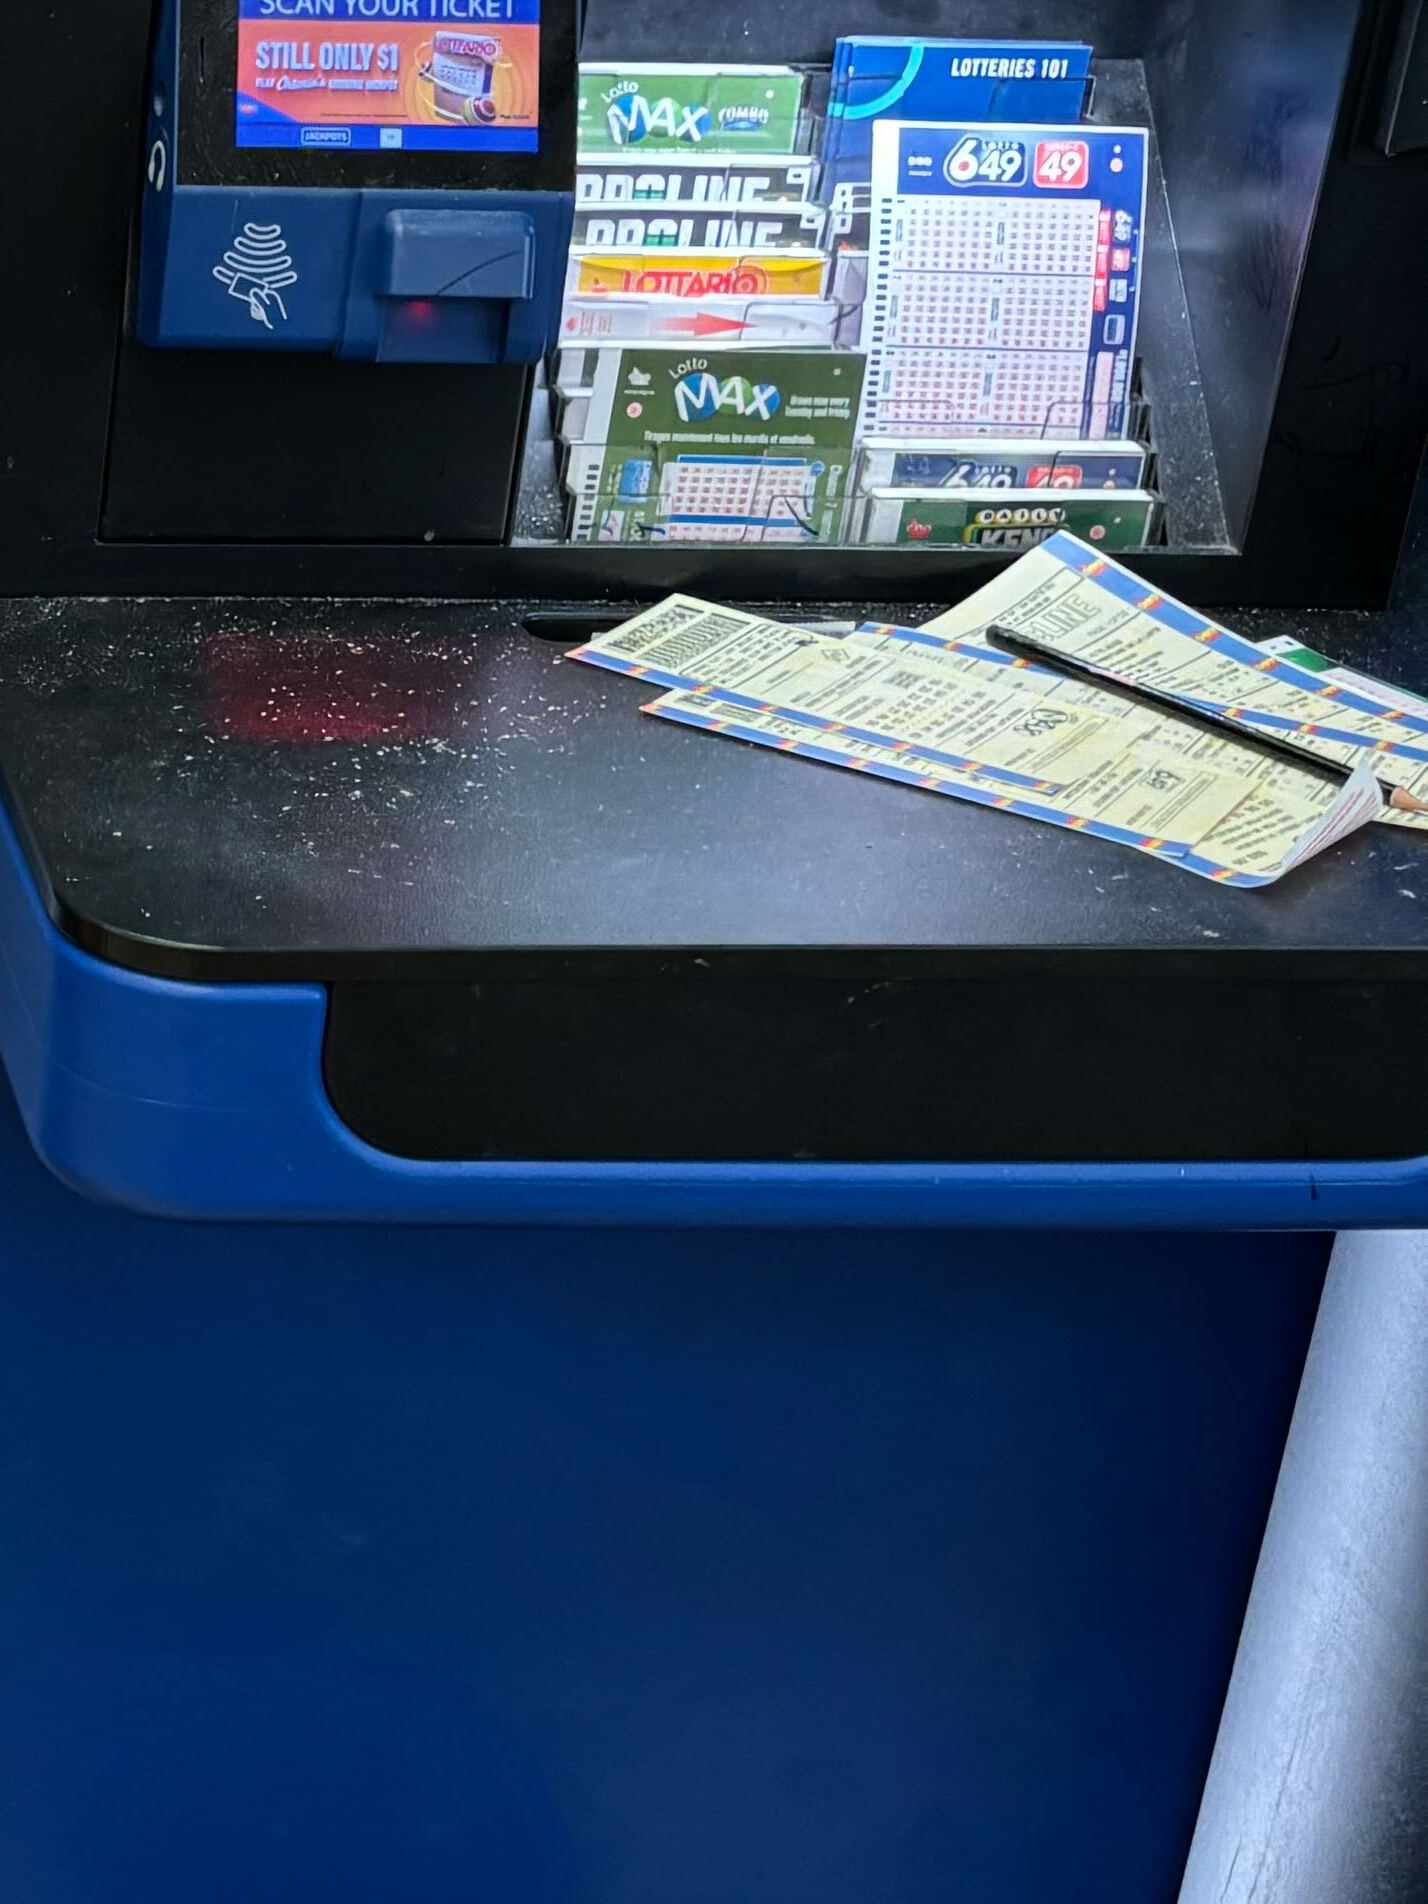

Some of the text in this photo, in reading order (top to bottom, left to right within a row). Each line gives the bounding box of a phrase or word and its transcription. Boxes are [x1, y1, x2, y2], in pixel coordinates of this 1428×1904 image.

[255, 42, 398, 72] STILL ONLY $1
[951, 57, 1068, 78] LOTTERIES 101
[601, 80, 639, 103] Lotto
[607, 95, 710, 145] MAX
[1040, 152, 1081, 182] 49
[668, 358, 708, 379] Lotto
[674, 373, 777, 422] MAX
